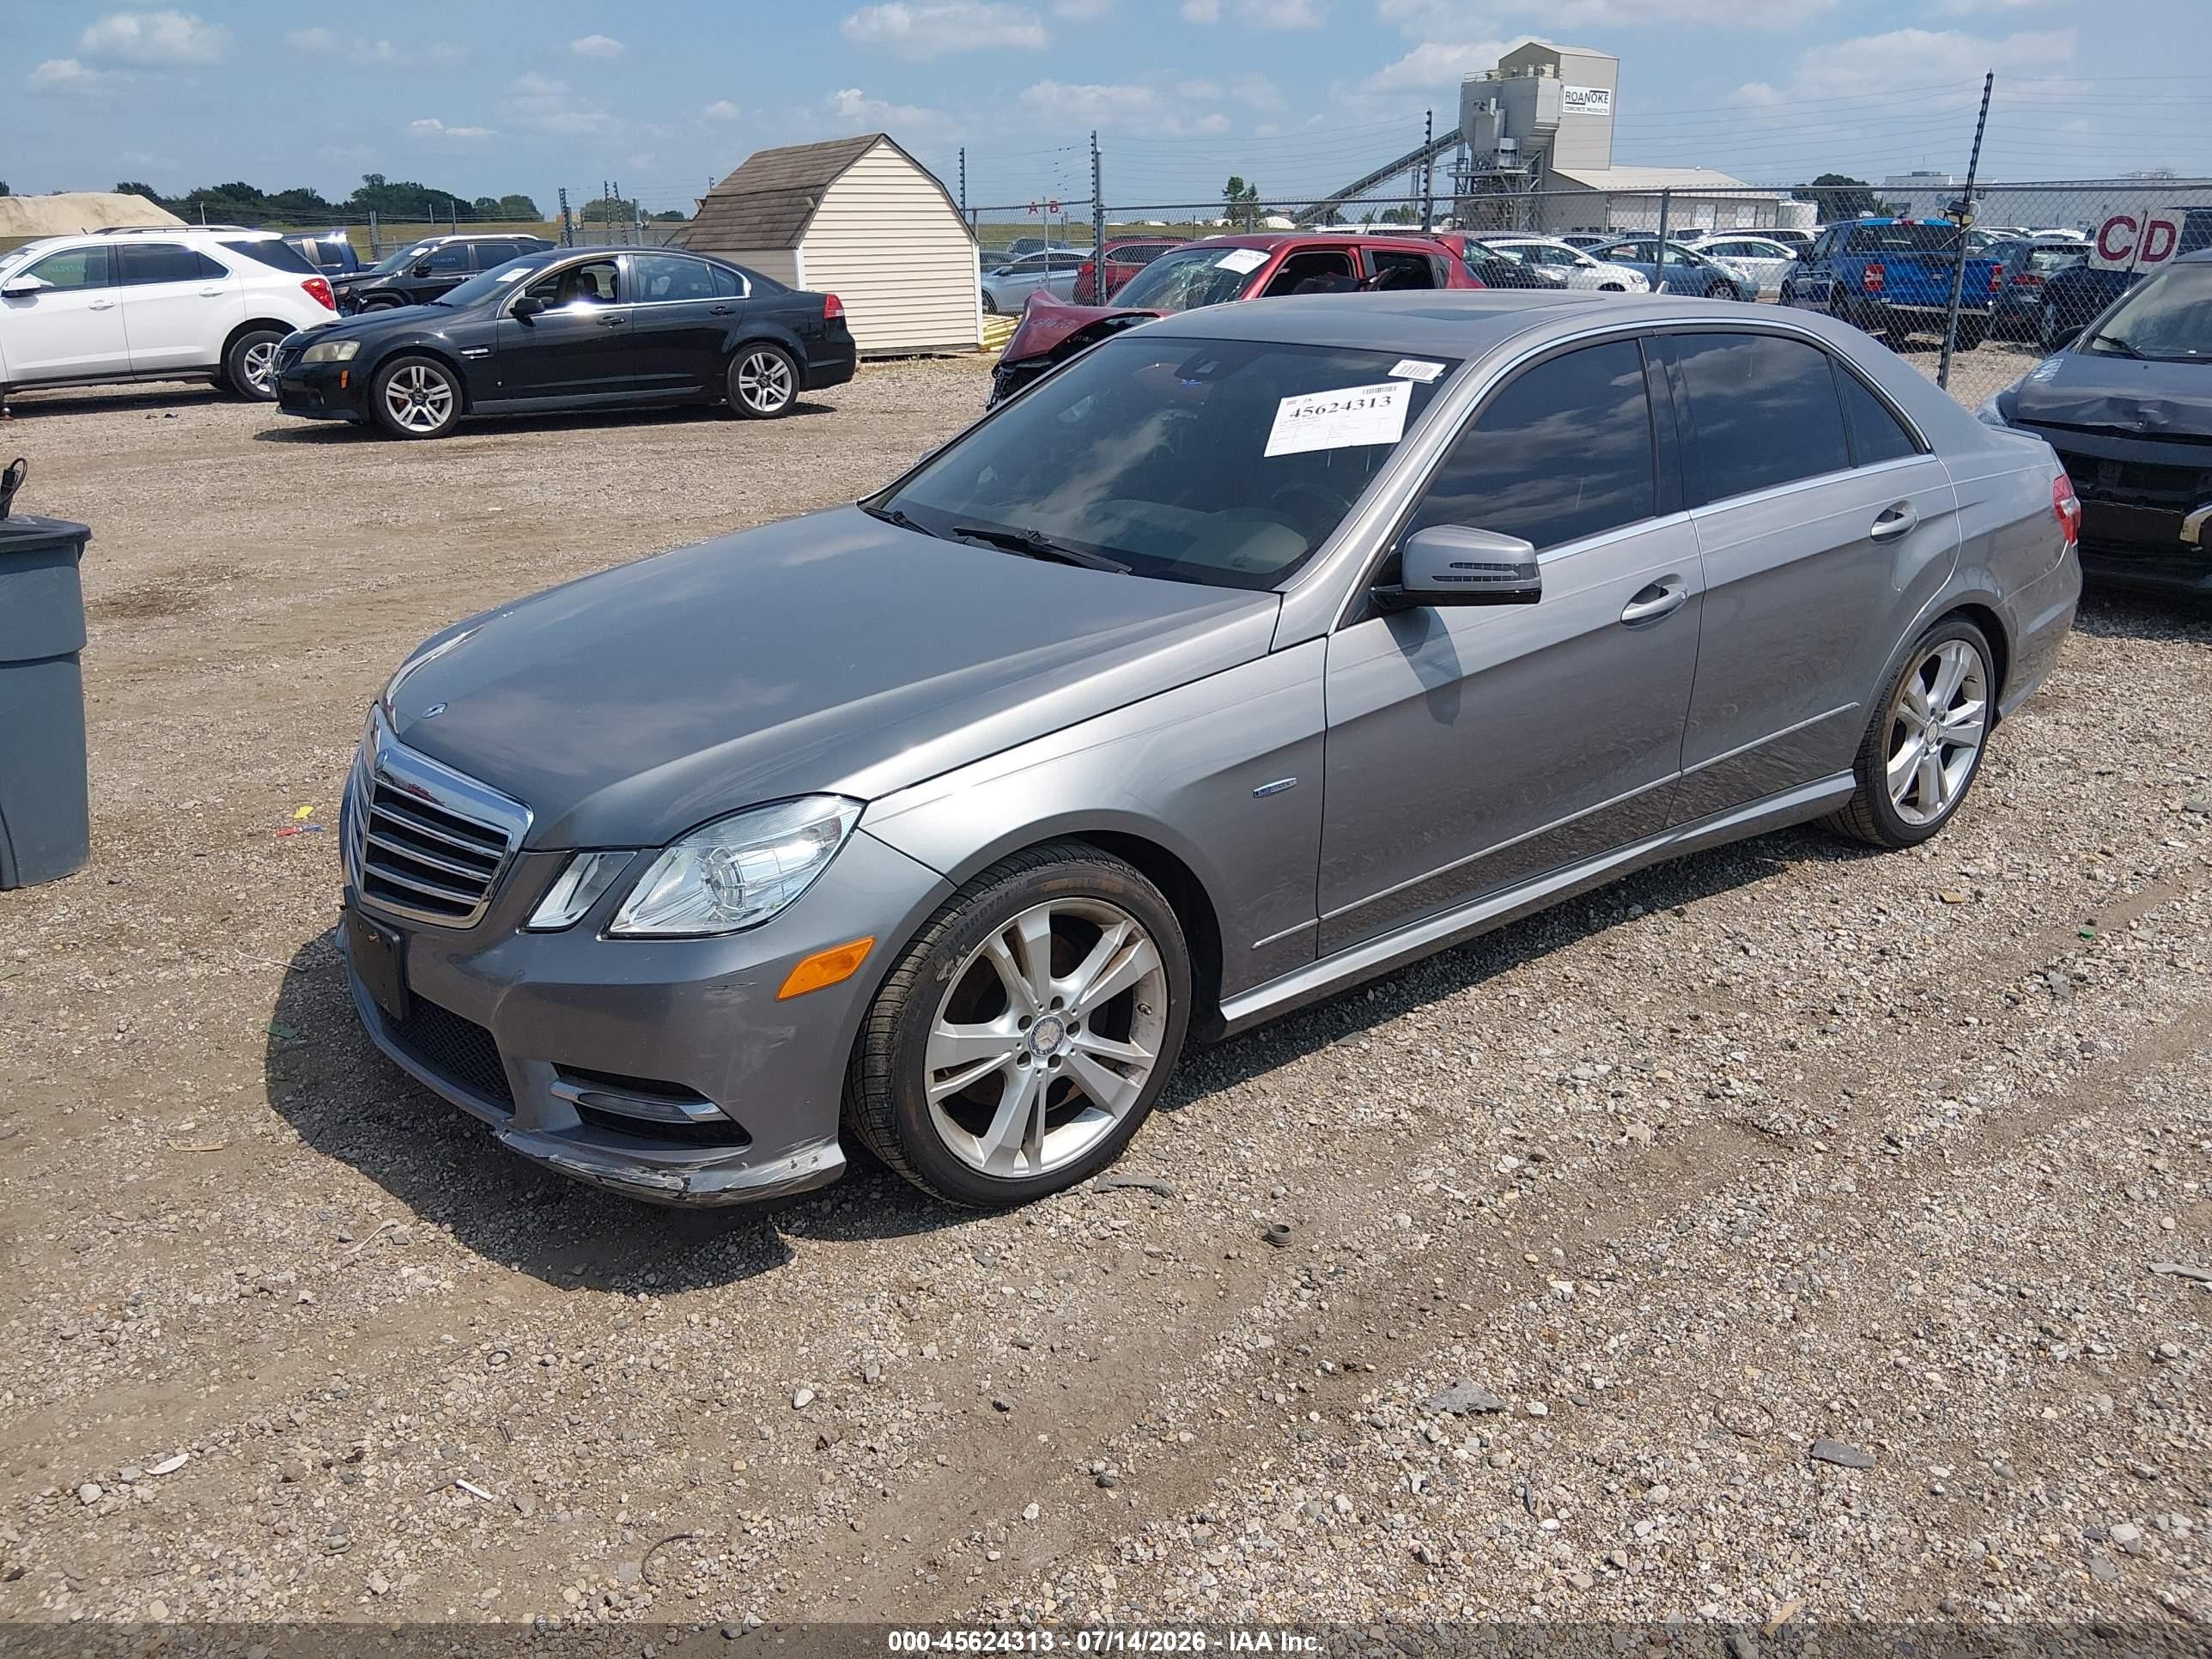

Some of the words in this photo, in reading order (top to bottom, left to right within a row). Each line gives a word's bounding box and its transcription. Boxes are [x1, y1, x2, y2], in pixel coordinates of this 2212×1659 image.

[1565, 91, 1608, 104] ROANOKE
[1028, 201, 1038, 215] A
[1049, 200, 1059, 214] B
[2098, 216, 2137, 261] C
[2140, 220, 2177, 263] D
[1289, 395, 1392, 418] 45624313
